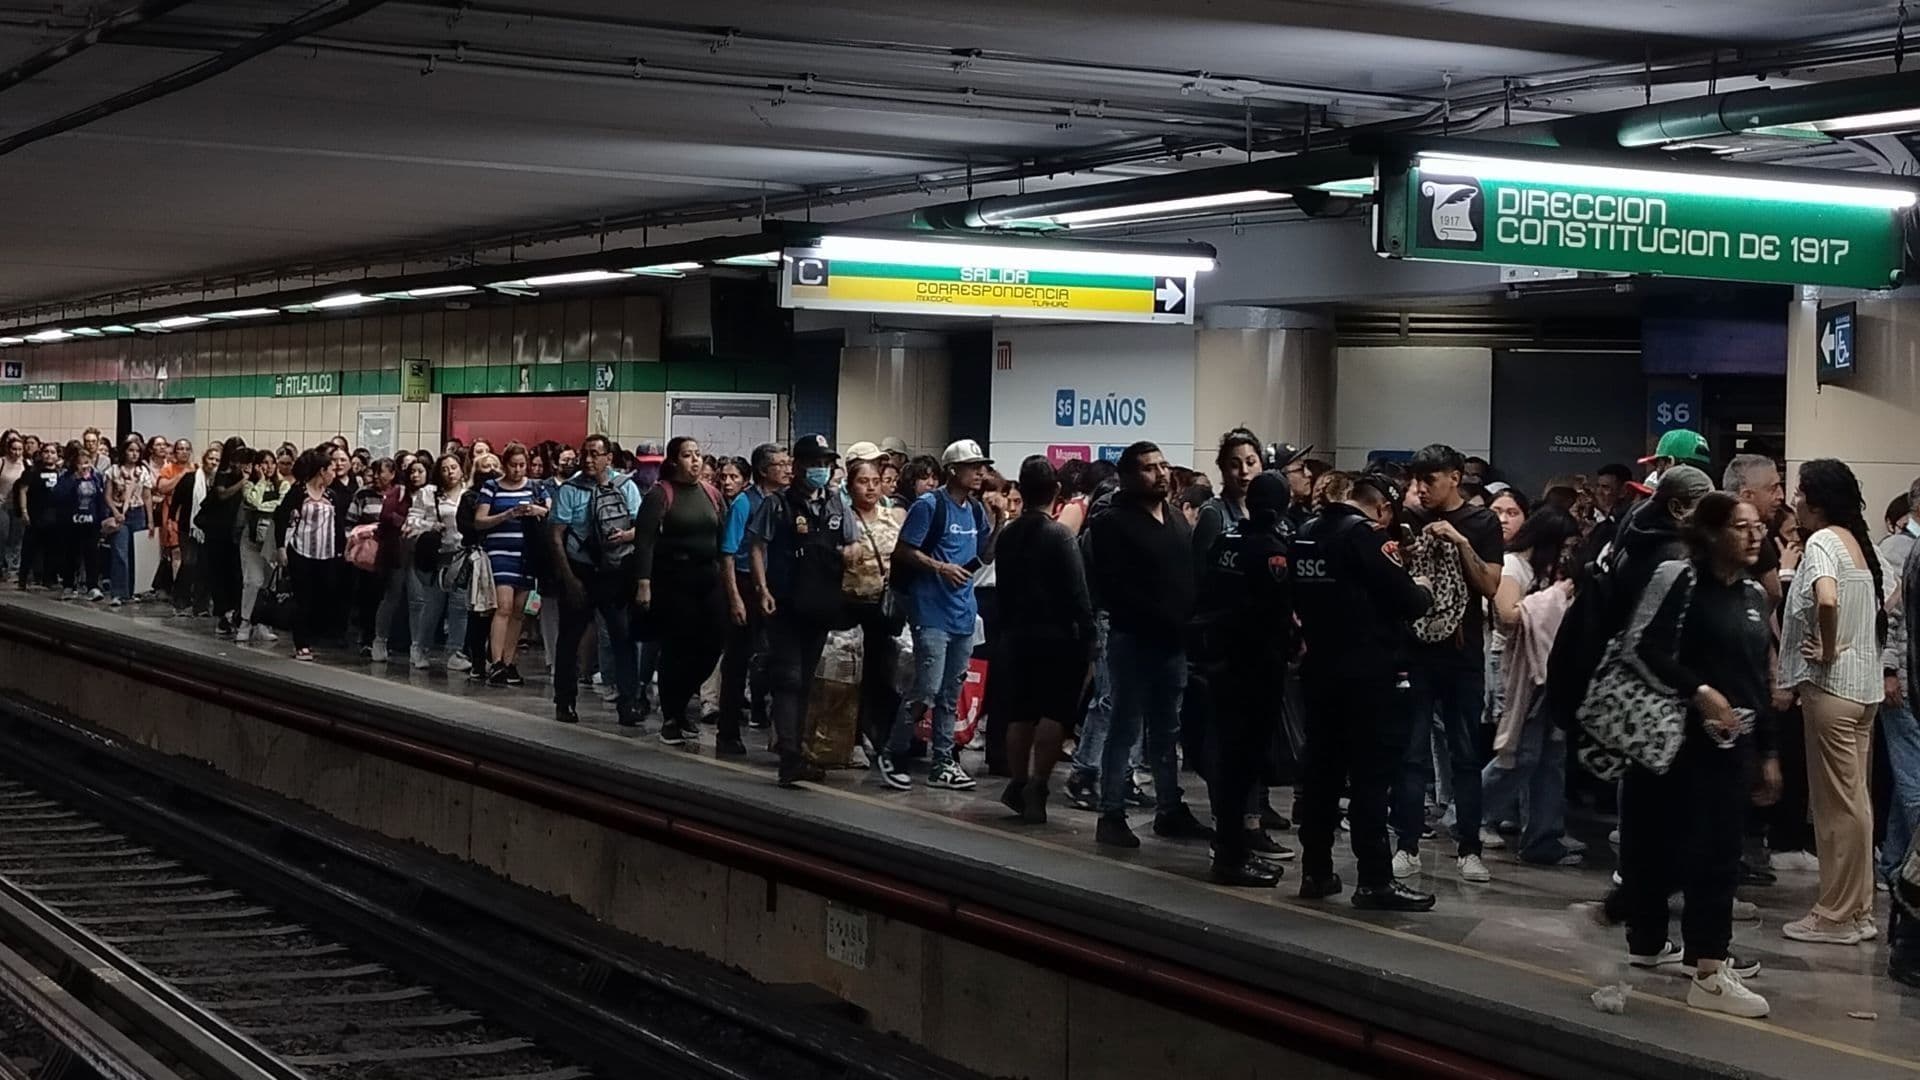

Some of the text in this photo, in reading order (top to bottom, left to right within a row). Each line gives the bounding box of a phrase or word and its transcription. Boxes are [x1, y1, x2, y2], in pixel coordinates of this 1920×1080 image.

[1498, 187, 1666, 225] DIRECCION
[1440, 215, 1459, 226] 1917
[1497, 216, 1849, 265] CONSTITUCION DE 1917
[798, 258, 823, 285] C
[960, 267, 1029, 284] SALIDA
[917, 282, 1069, 300] CORRESPONDENCIA
[1058, 392, 1146, 426] $6 BAÑOS
[1657, 401, 1690, 425] $6
[1554, 435, 1597, 446] SALIDA
[1218, 550, 1239, 568] SC
[1296, 559, 1326, 577] SSC
